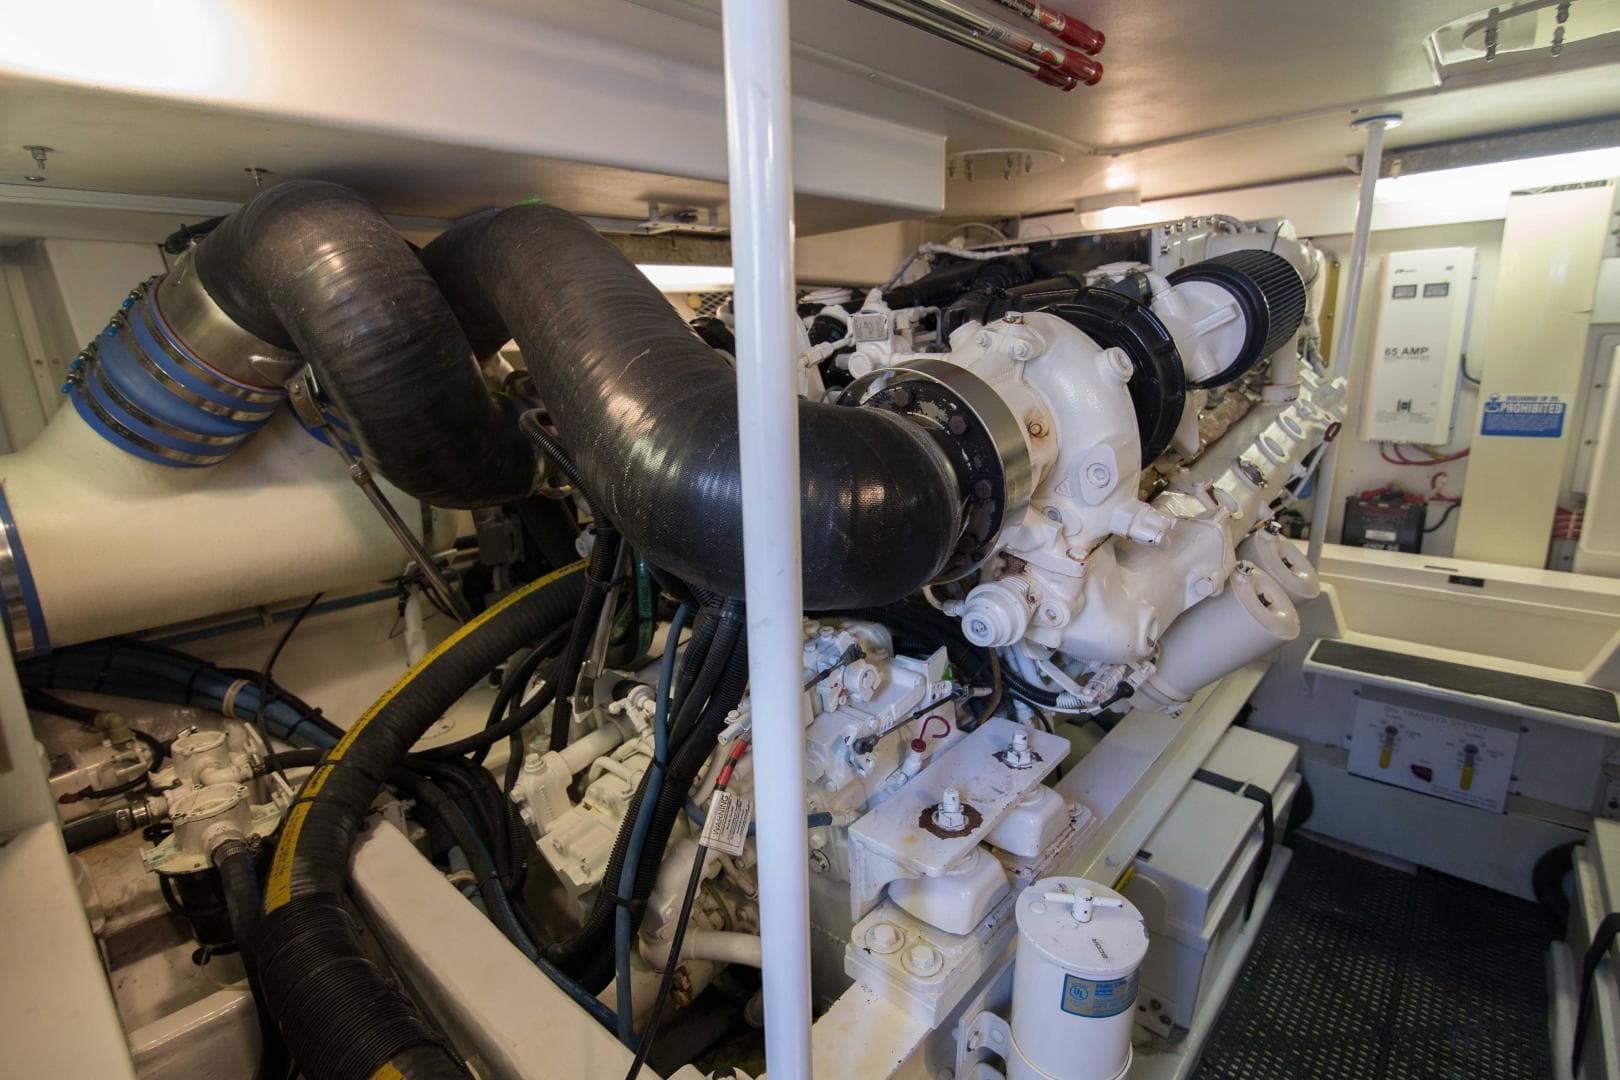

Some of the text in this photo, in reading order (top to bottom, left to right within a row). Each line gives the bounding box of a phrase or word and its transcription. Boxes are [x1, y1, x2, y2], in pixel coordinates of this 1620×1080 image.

[1384, 346, 1429, 356] 65 AMP
[1500, 402, 1562, 414] PROHIBITED
[712, 795, 728, 835] WARNING
